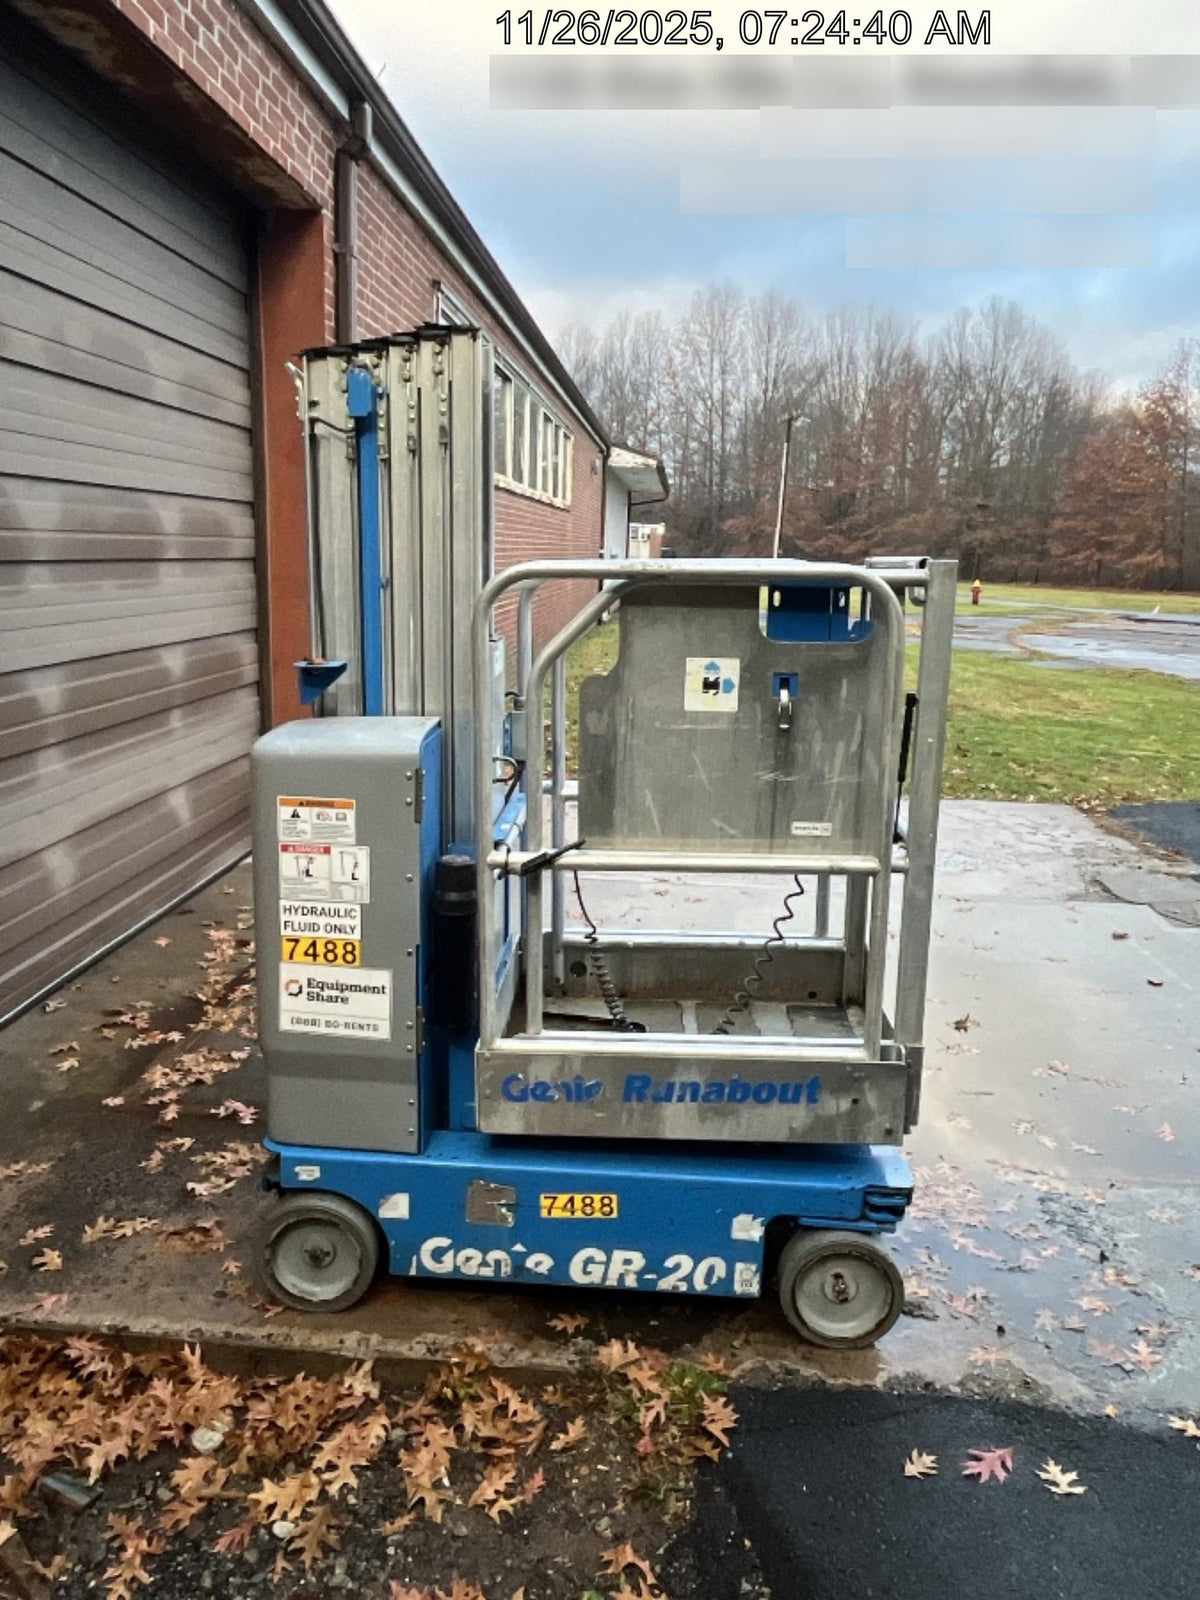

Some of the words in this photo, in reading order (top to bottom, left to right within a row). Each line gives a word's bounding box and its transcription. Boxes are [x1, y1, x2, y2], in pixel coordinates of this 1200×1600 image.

[283, 904, 358, 920] HYDRAULIC
[283, 920, 321, 933] FLUID
[324, 922, 357, 935] ONLY
[285, 938, 357, 965] 7488
[306, 977, 387, 995] Equipment
[306, 991, 350, 1005] Share
[621, 1073, 822, 1105] Runabout
[543, 1195, 615, 1218] 7488
[420, 1236, 556, 1278] Gene
[568, 1247, 727, 1292] GR-20
